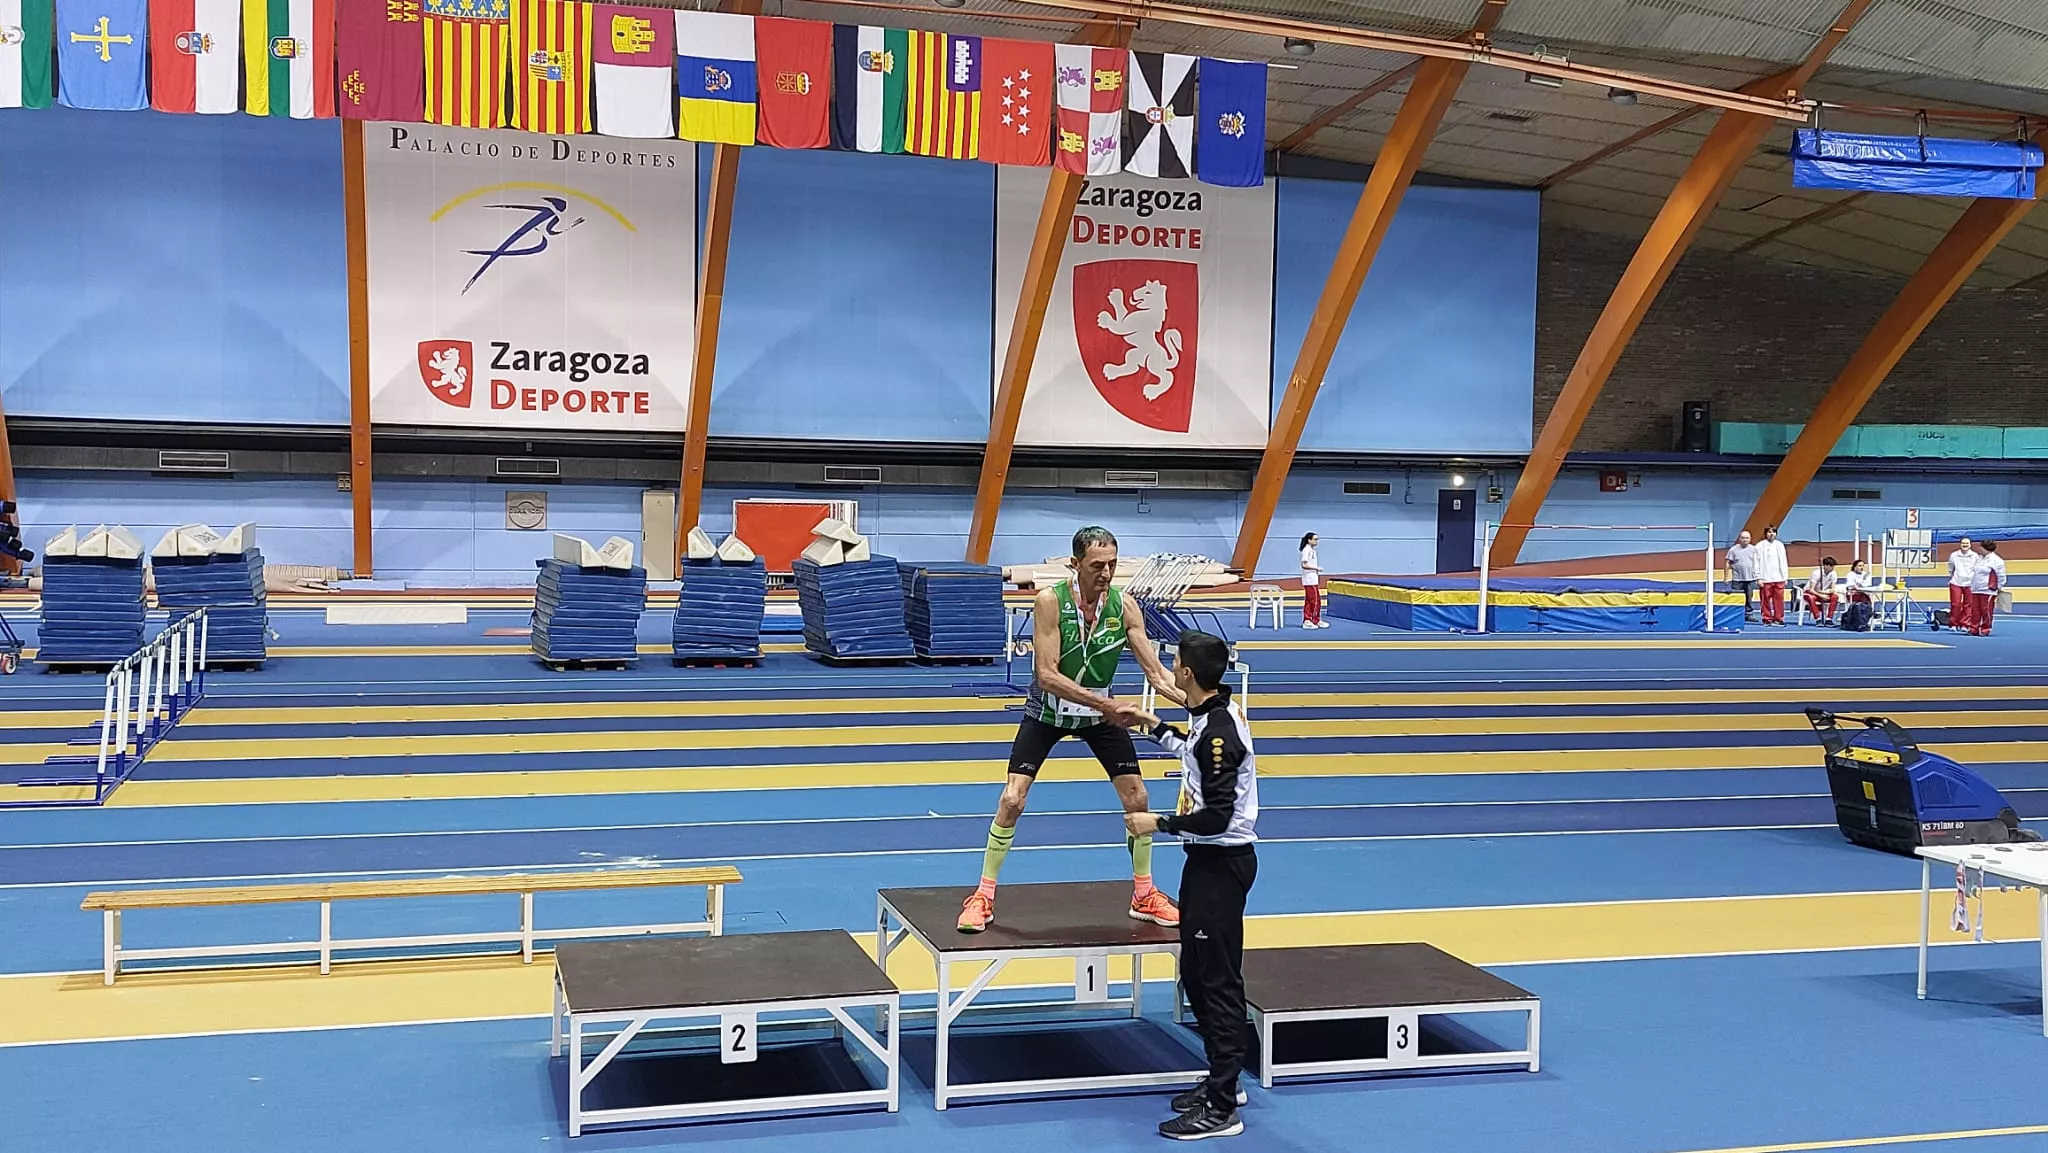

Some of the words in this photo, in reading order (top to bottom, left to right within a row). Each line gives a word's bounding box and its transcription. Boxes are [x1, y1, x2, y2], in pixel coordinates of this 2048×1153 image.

[389, 126, 500, 158] PALACIO
[511, 144, 539, 160] DE
[551, 138, 677, 169] DEPORTES
[1076, 180, 1202, 218] Zaragoza
[1072, 214, 1202, 250] DEPORTE
[490, 341, 650, 383] Zaragoza
[490, 378, 650, 414] DEPORTE
[1908, 508, 1917, 523] 3
[1899, 549, 1930, 564] 173
[1064, 629, 1115, 646] Husca
[1086, 964, 1094, 992] 1
[732, 1023, 747, 1052] 2
[1396, 1023, 1409, 1050] 3
